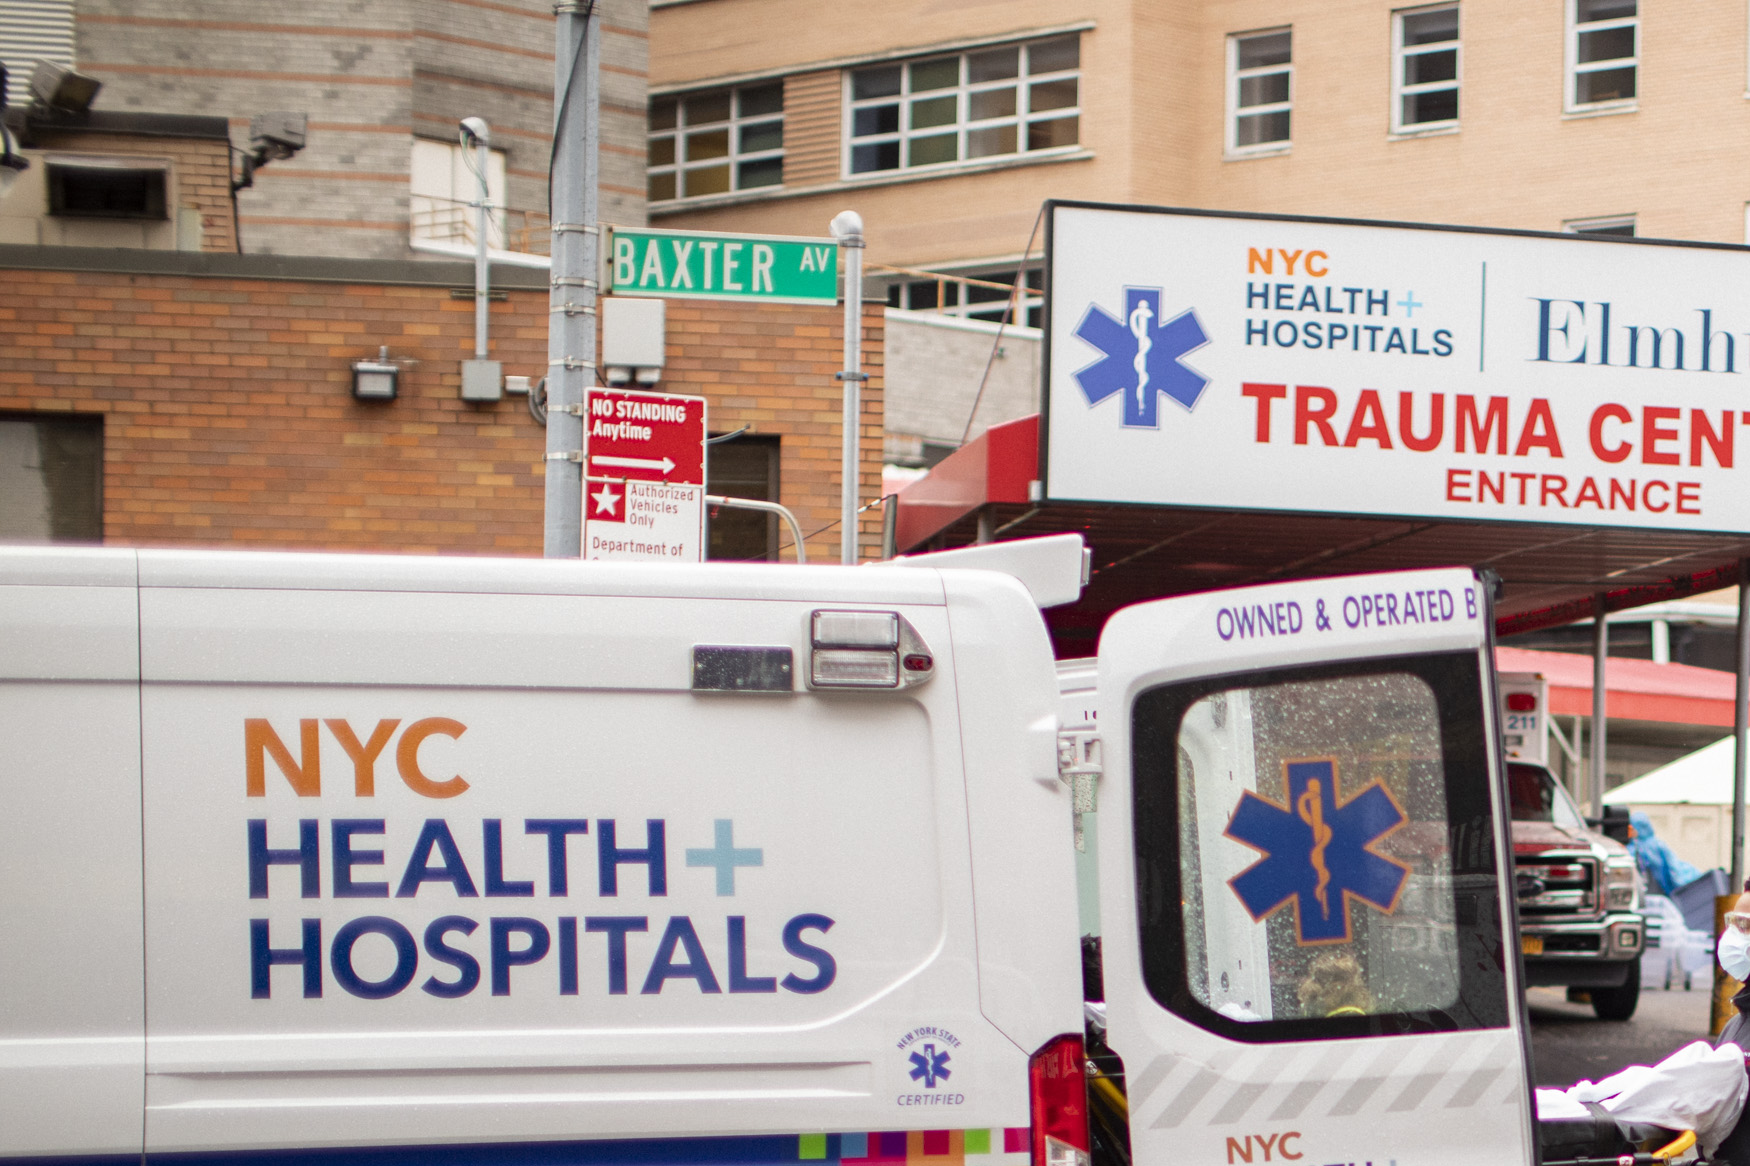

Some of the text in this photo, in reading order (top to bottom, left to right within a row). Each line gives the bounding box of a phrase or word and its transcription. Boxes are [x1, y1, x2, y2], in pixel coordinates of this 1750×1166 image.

[613, 237, 830, 293] BAXTER AV
[1248, 247, 1329, 278] NYC
[1246, 318, 1455, 357] HOSPITALS
[592, 398, 687, 424] NO STANDING
[1241, 382, 1564, 459] TRAUMA
[593, 419, 653, 442] Anytime
[631, 485, 694, 502] Authorized
[1446, 468, 1702, 515] ENTRANCE
[631, 499, 678, 514] Vehicles
[630, 513, 655, 529] Only
[593, 537, 684, 556] Department of
[1216, 601, 1303, 641] OWNED
[1315, 598, 1333, 632] &
[1343, 589, 1455, 628] OPERATED
[1508, 715, 1536, 730] 211
[244, 717, 470, 799] NYC
[249, 912, 838, 1000] HOSPITALS
[896, 1026, 962, 1050] NEW YORK STATE
[897, 1093, 966, 1106] CERTIFIED
[1226, 1131, 1304, 1165] NYC
